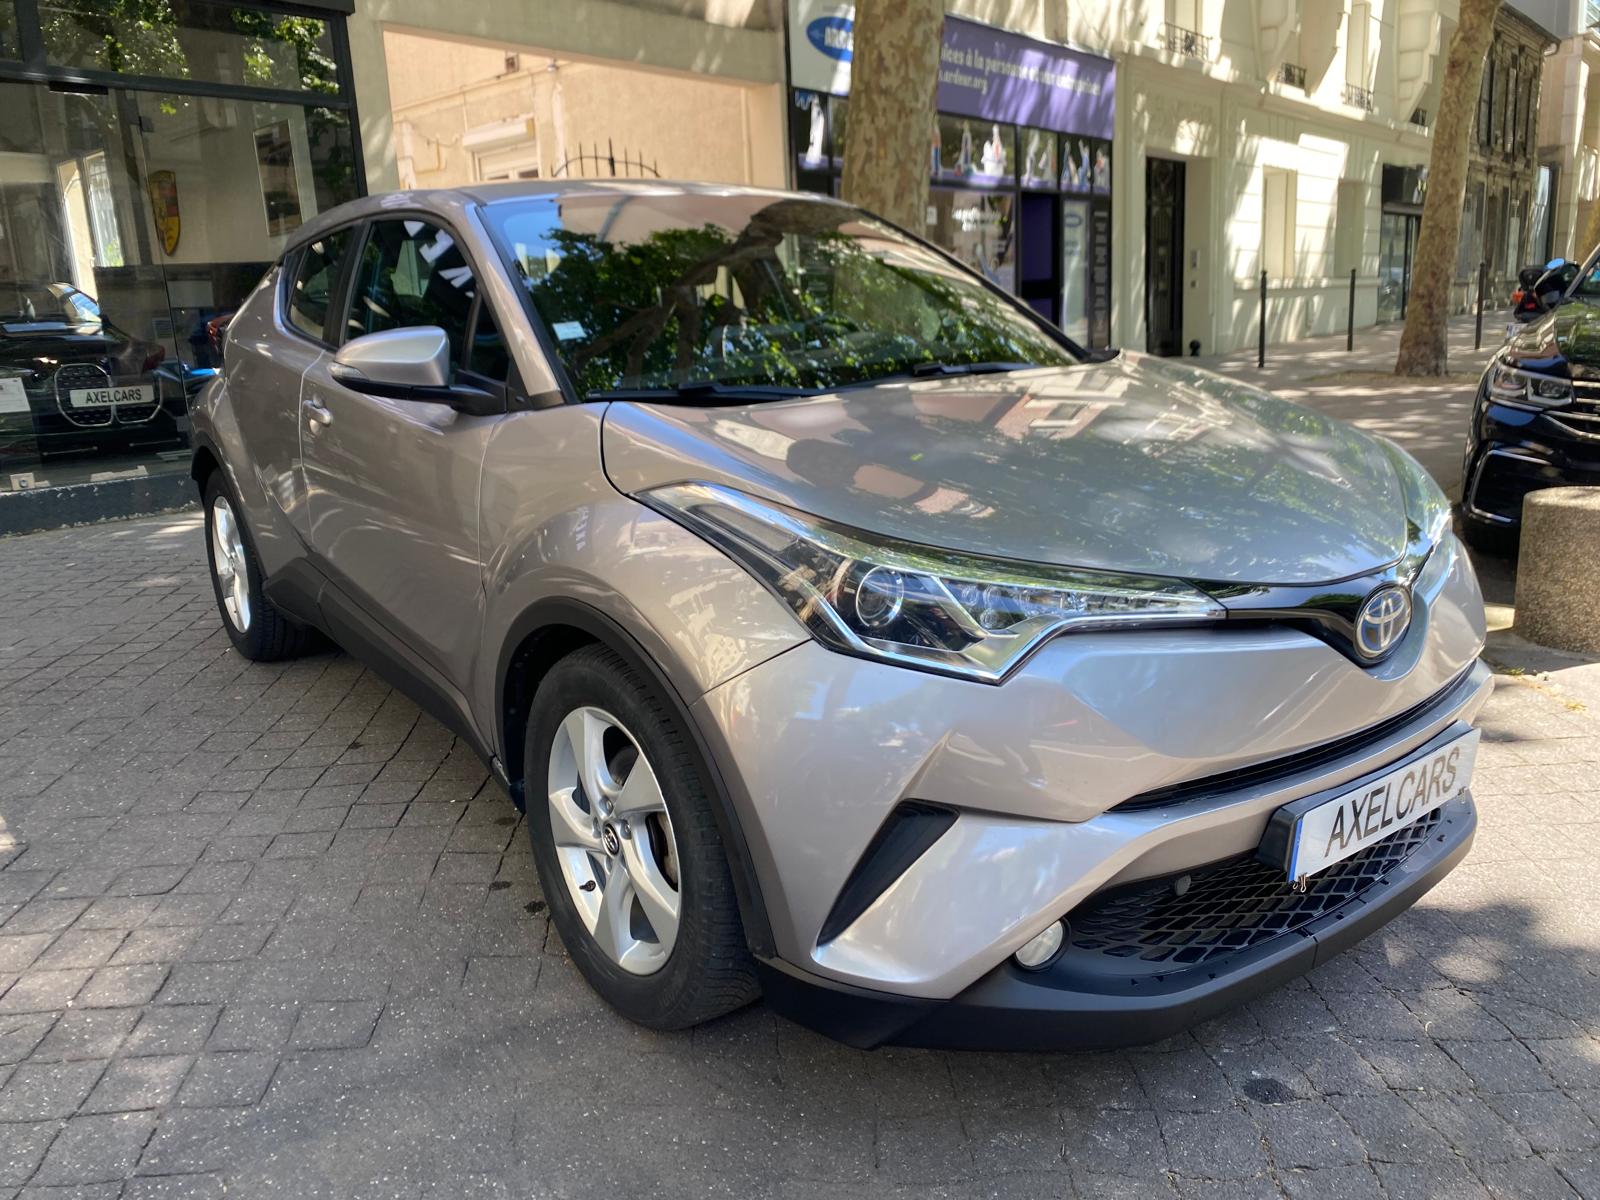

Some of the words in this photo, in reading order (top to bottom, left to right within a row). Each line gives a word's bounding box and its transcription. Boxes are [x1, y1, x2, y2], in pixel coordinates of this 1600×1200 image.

[966, 47, 973, 67] à
[975, 48, 984, 69] la
[985, 57, 1028, 79] personne
[86, 388, 142, 404] AXELCARS
[1325, 746, 1460, 858] AXELCARS
